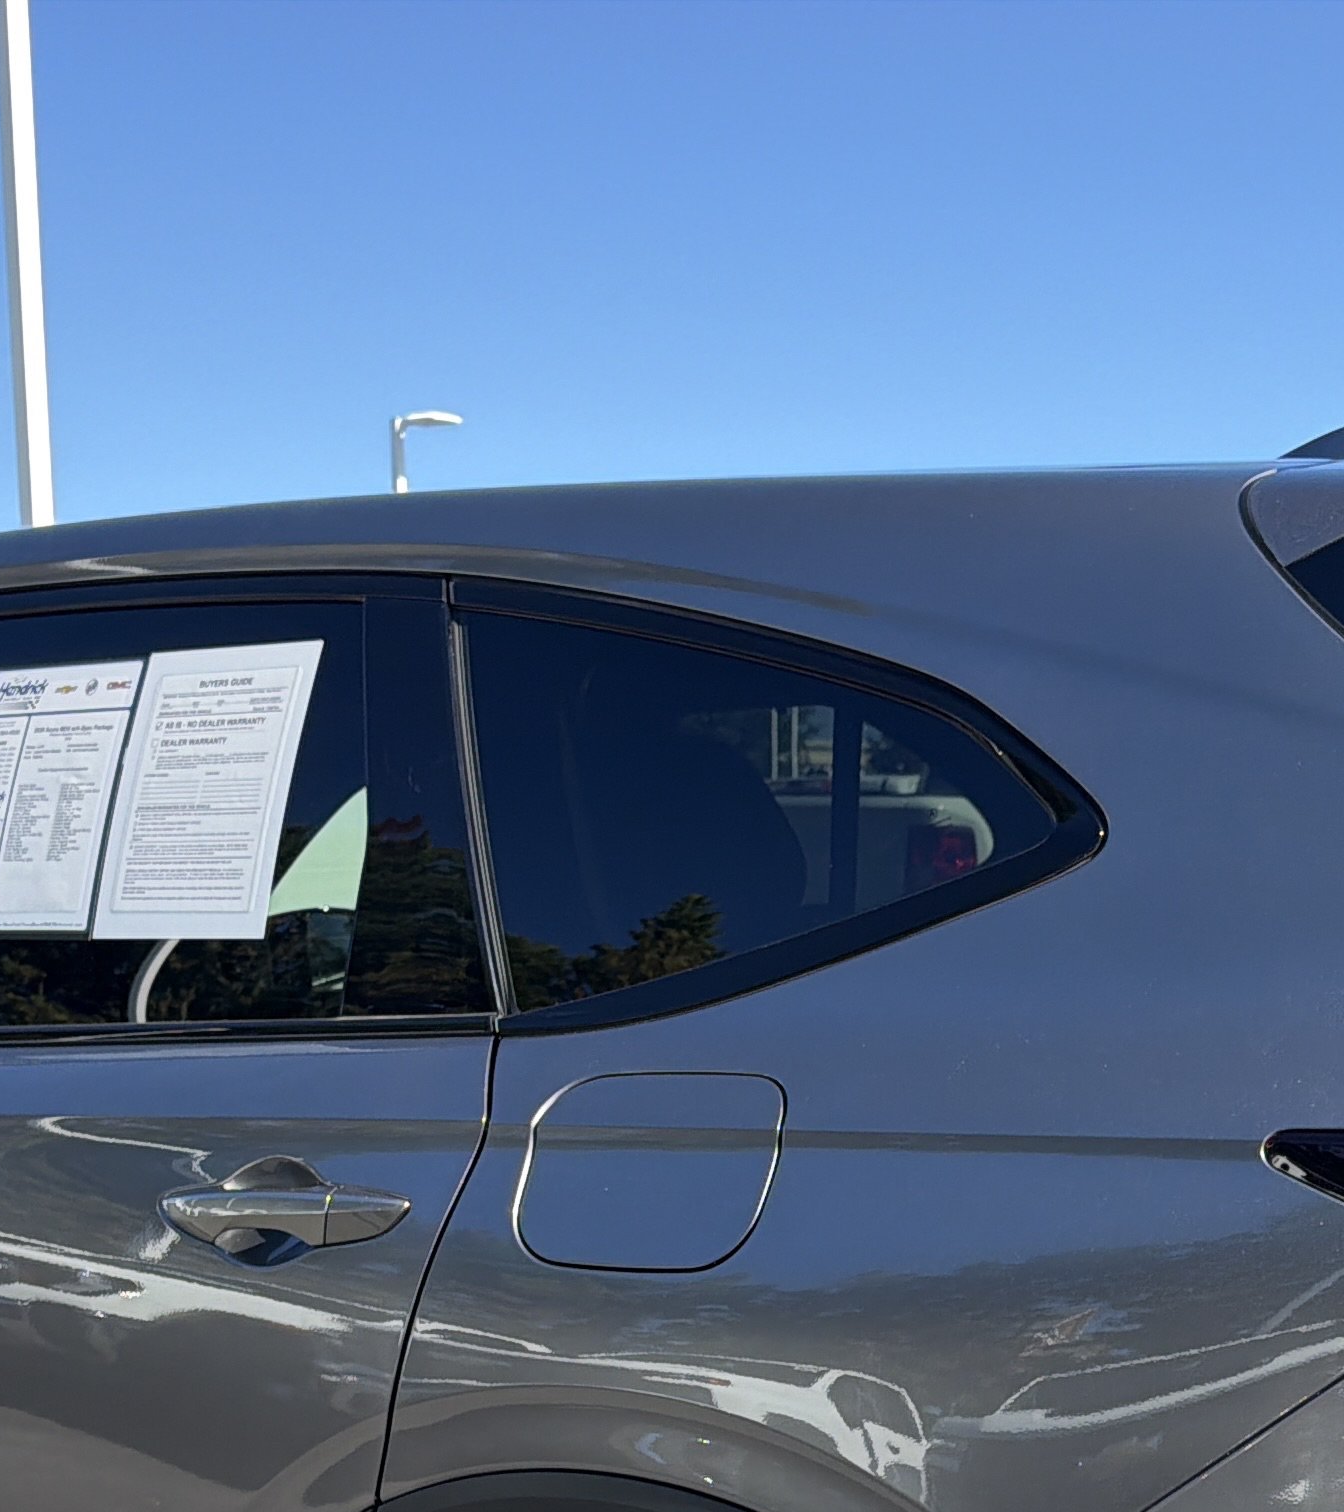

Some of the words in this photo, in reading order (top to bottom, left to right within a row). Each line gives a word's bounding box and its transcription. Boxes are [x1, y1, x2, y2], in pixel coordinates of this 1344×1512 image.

[199, 679, 229, 688] BUYERS
[230, 677, 255, 686] GUIDE
[198, 718, 226, 728] DEALER
[227, 717, 267, 727] WARRANTY
[160, 738, 187, 747] DEALER
[189, 737, 228, 746] WARRANTY
